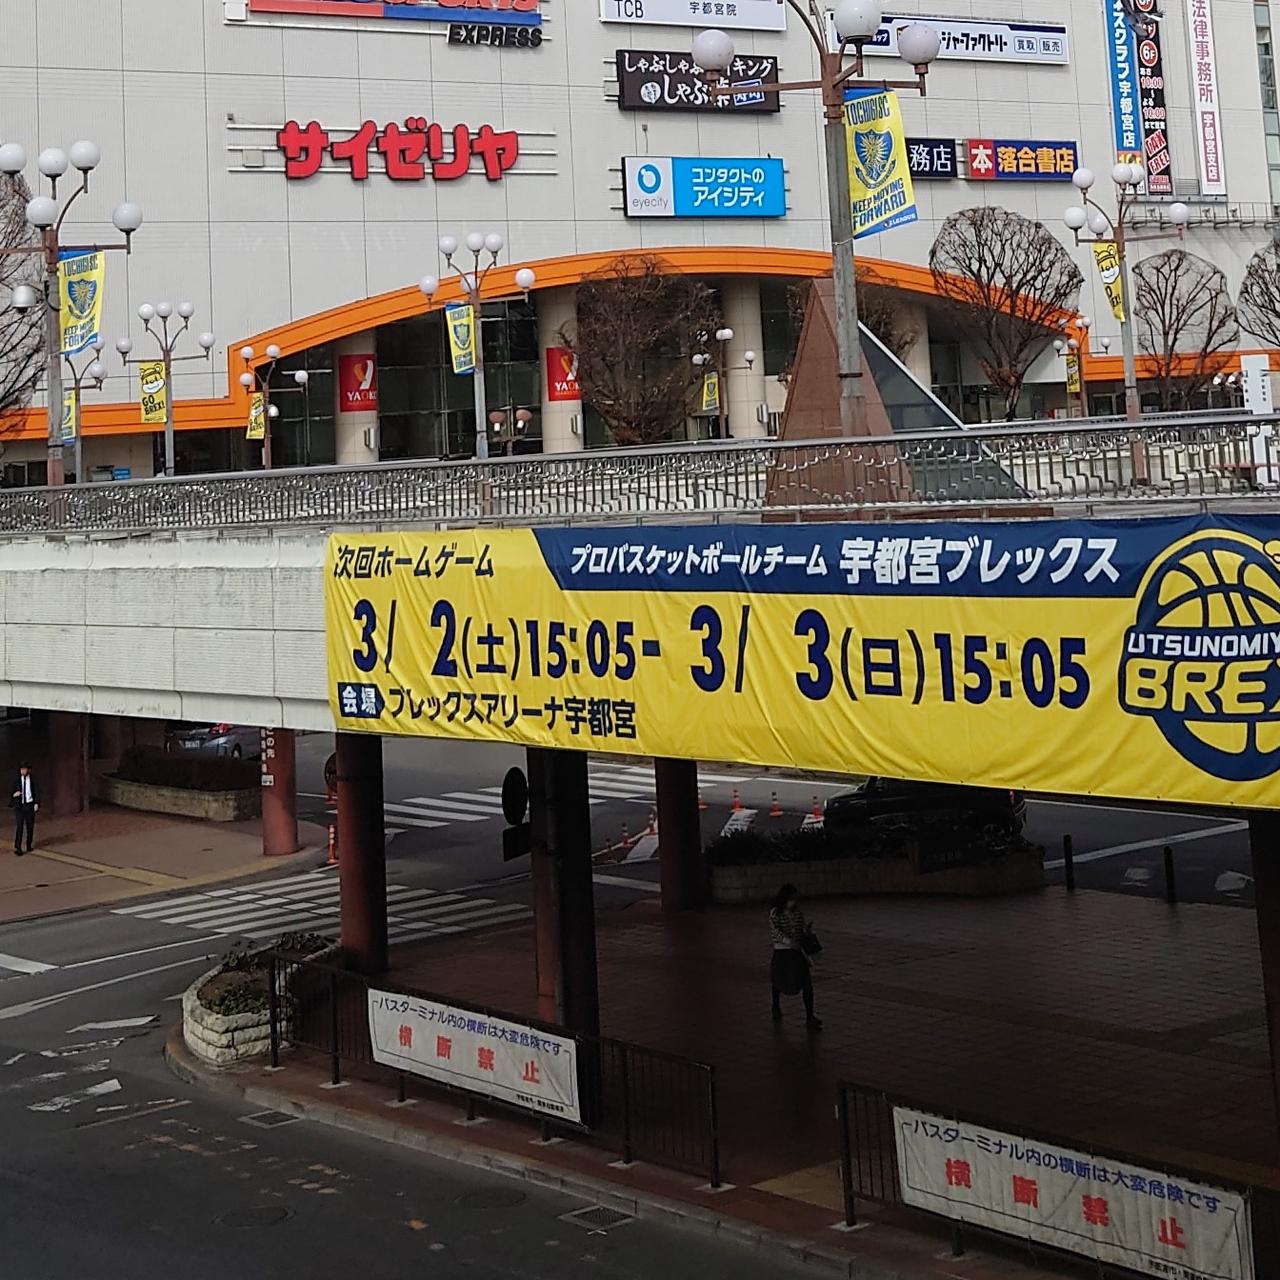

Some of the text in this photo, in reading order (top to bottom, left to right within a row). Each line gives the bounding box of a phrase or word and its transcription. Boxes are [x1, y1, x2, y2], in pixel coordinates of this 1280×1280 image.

[689, 0, 738, 18] 宇都宮院
[448, 24, 543, 48] EXPRESS
[939, 31, 1008, 53] ジャーファクトリー
[1017, 38, 1062, 53] 買取 販売
[277, 116, 519, 181] サイゼリヤ
[909, 144, 951, 172] 務店
[971, 144, 1075, 173] 本 落合書店
[1202, 113, 1219, 180] 宇都宮支店
[691, 167, 765, 185] コンタクトの
[632, 197, 669, 210] eyecity
[693, 186, 765, 208] アイシティ
[852, 194, 872, 214] KEEP
[853, 190, 907, 231] FORWARD
[142, 396, 155, 408] GO
[144, 400, 166, 417] BREX!
[333, 542, 495, 580] 次回ホームゲーム
[570, 536, 1120, 587] プロバスケットボールチーム 宇都宮ブレックス
[341, 683, 637, 740] 会場 ブレックスアリーナ宇都宮
[378, 995, 563, 1056] バスターミナル内の横断は大変危険です
[398, 1023, 541, 1085] 横断禁止
[913, 1118, 1222, 1215] バスターミナル内の横断は大変危険です
[944, 1157, 1186, 1250] 横断禁止
